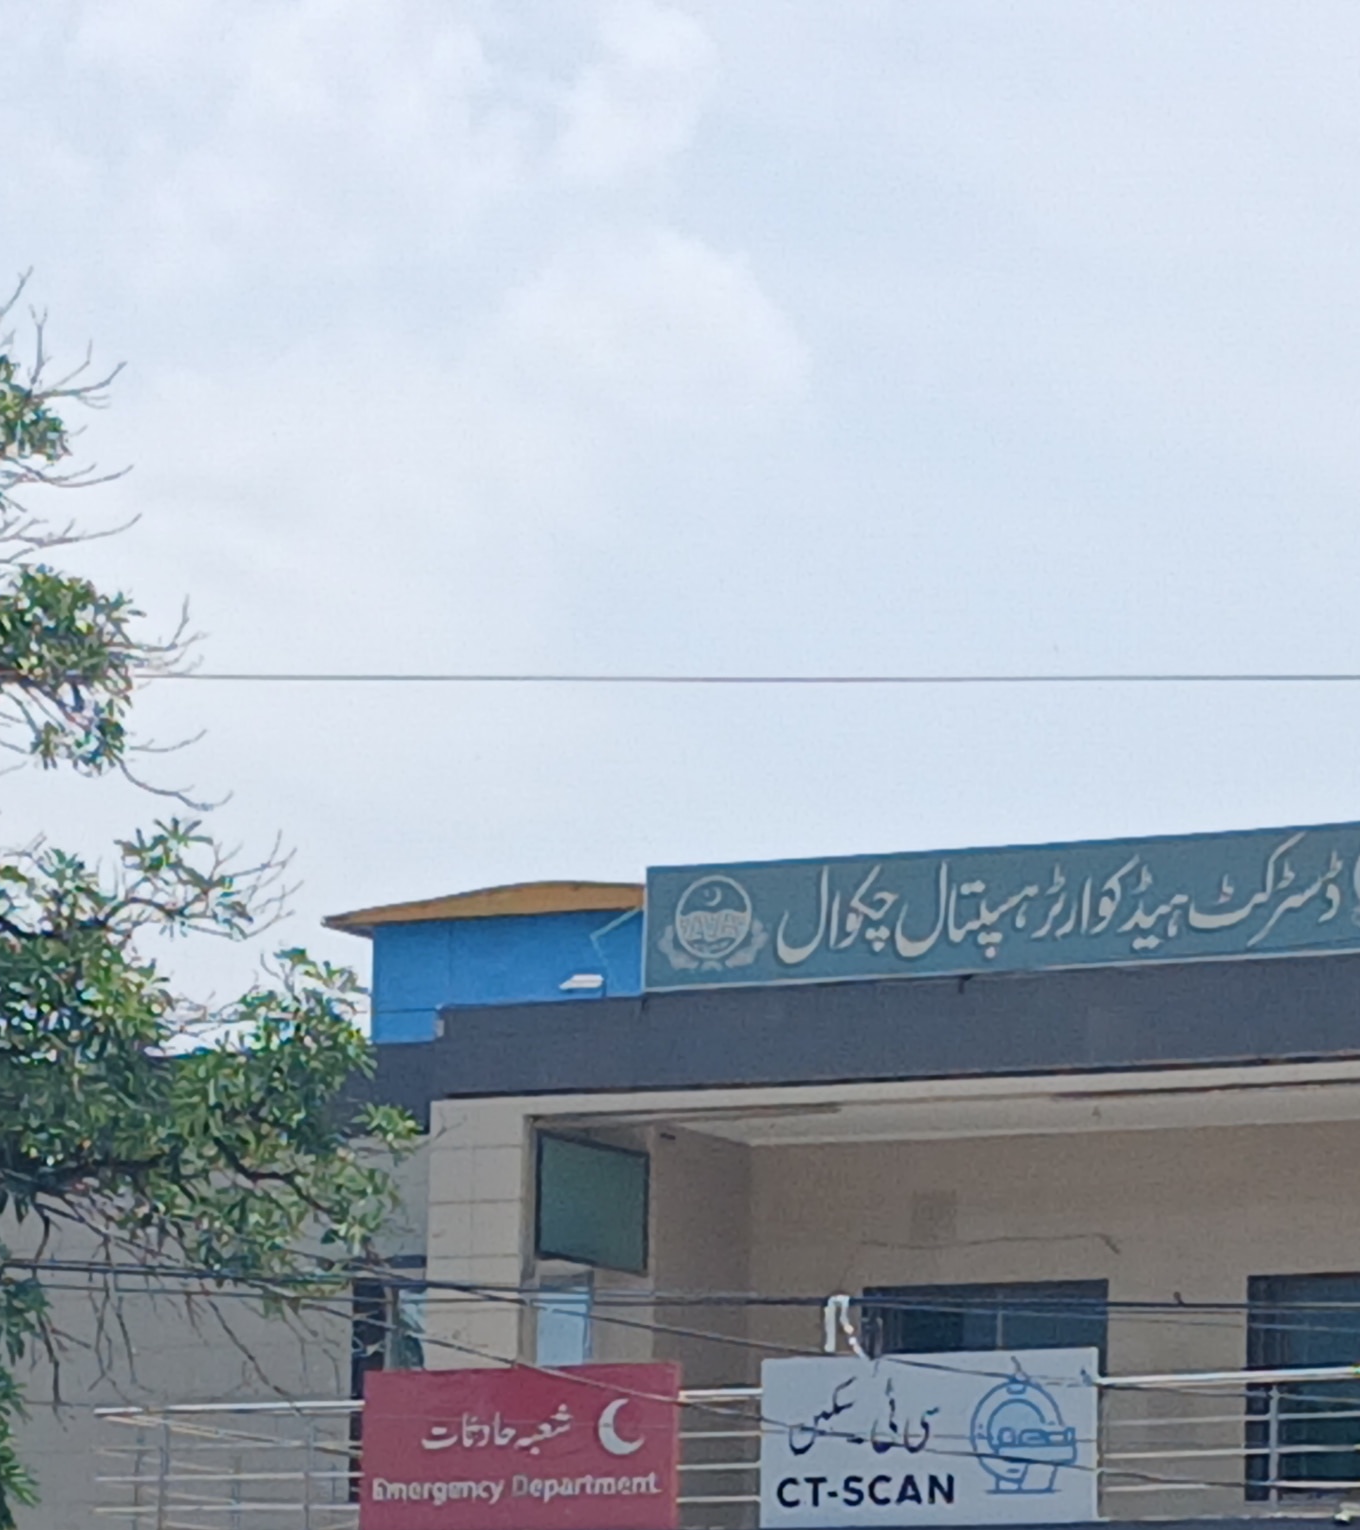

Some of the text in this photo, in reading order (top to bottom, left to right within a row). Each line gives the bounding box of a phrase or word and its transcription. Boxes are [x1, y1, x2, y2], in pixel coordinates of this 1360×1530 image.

[776, 863, 899, 965] چکوال
[894, 859, 1040, 959] ہسپتال
[1188, 831, 1344, 948] ڈسٹرکٹ
[420, 1402, 574, 1456] شعبہ حادثات
[371, 1471, 663, 1506] Emergency Department
[776, 1473, 956, 1509] CT-SCAN
